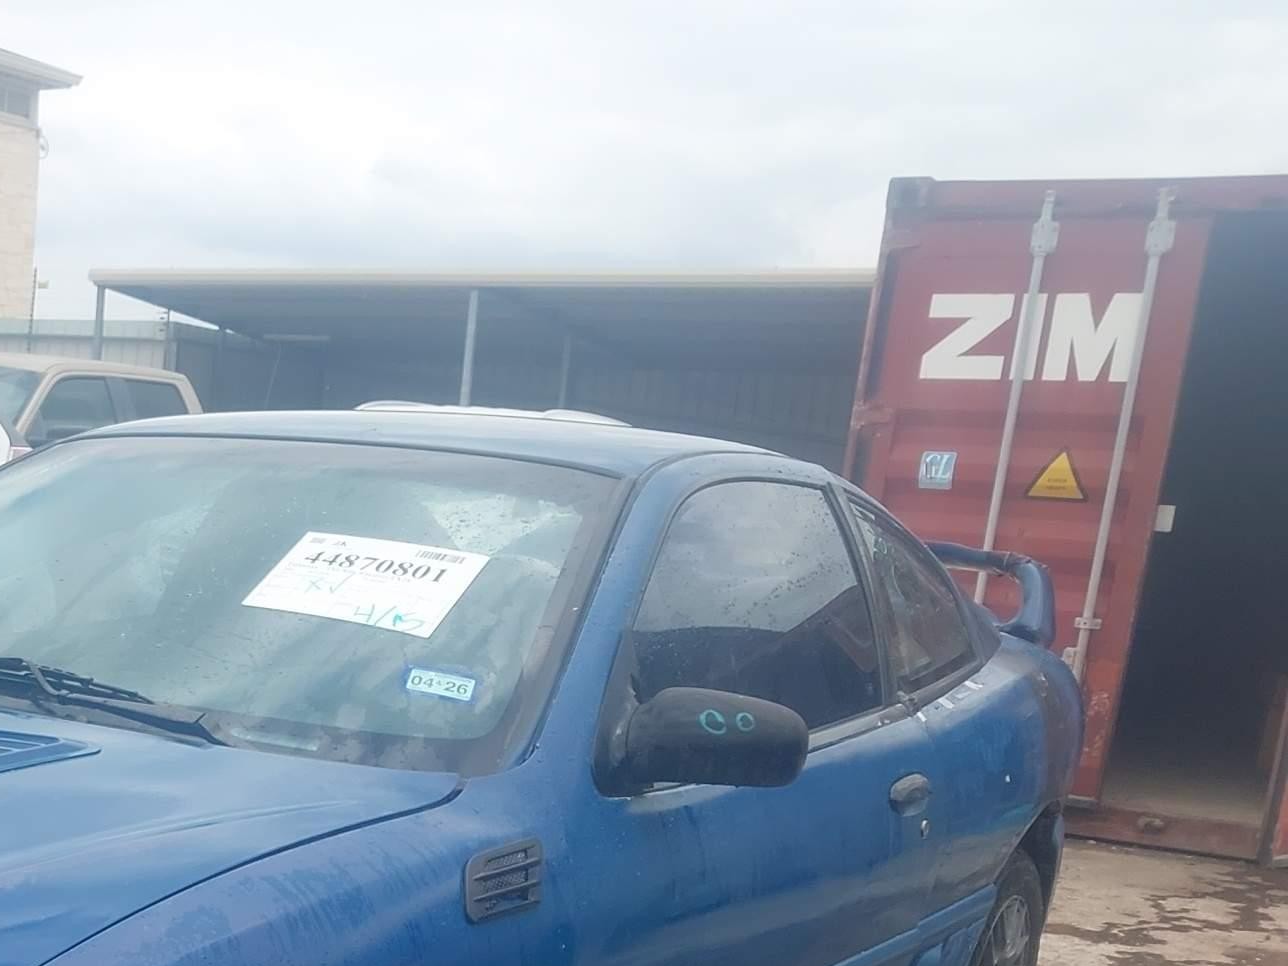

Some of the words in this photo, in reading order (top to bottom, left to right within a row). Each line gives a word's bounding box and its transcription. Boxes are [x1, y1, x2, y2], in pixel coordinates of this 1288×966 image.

[919, 293, 1146, 382] ZIM
[304, 551, 449, 583] 44870801
[411, 675, 434, 689] 04
[443, 681, 469, 695] 26
